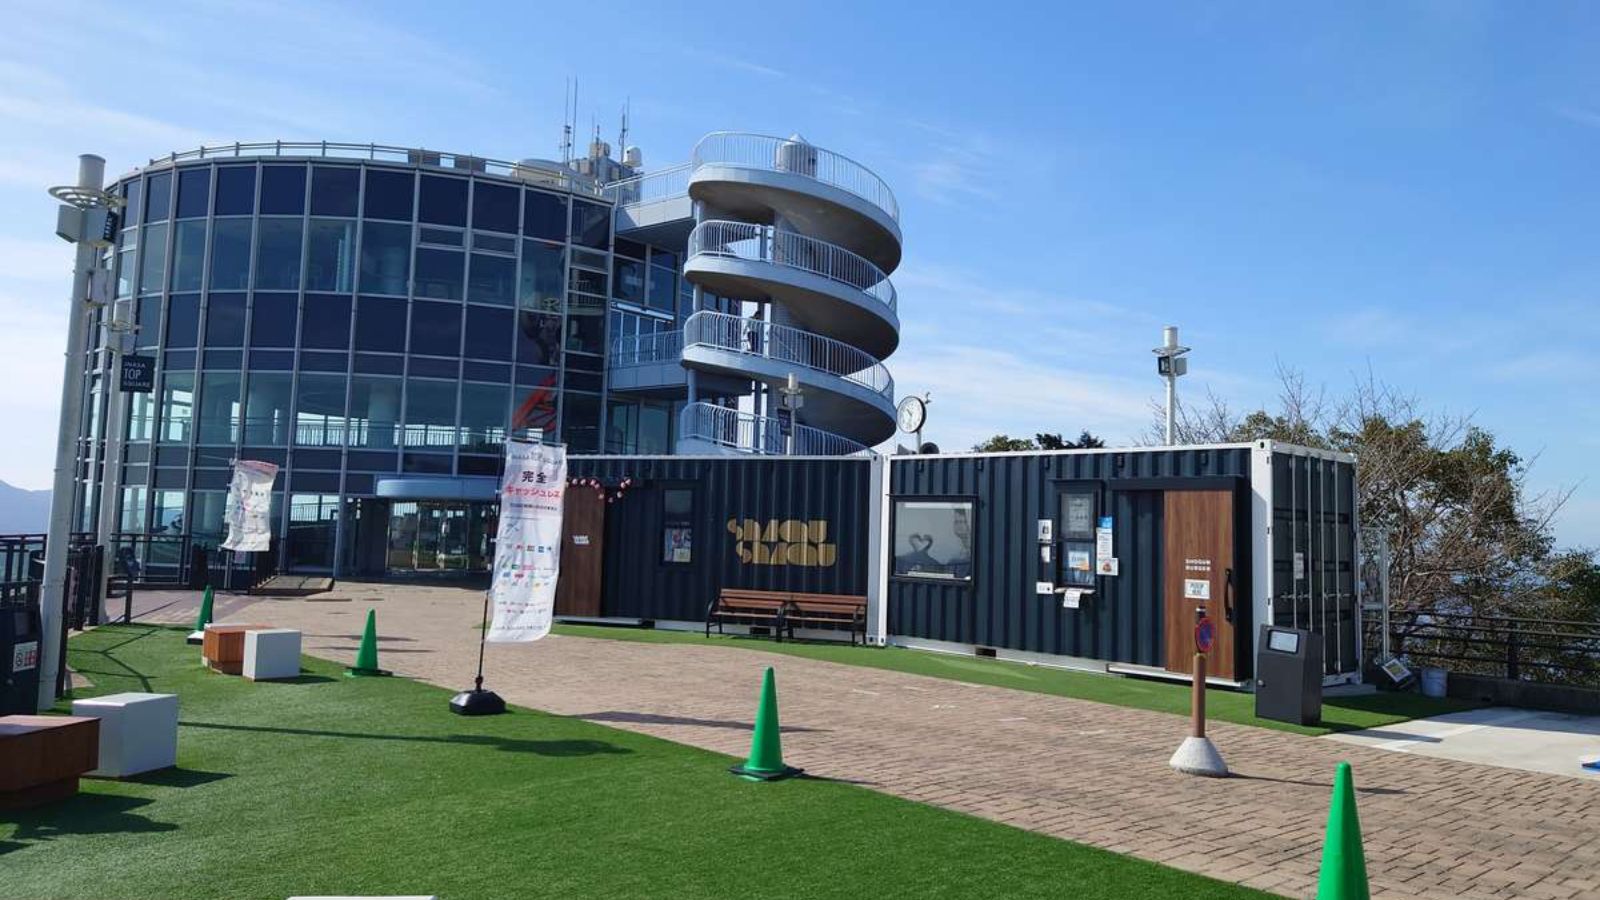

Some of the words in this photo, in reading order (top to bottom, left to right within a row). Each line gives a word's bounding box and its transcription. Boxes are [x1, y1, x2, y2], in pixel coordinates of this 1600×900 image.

[124, 368, 142, 380] TOP
[521, 470, 547, 484] 完全
[505, 483, 561, 498] キャッシュレス
